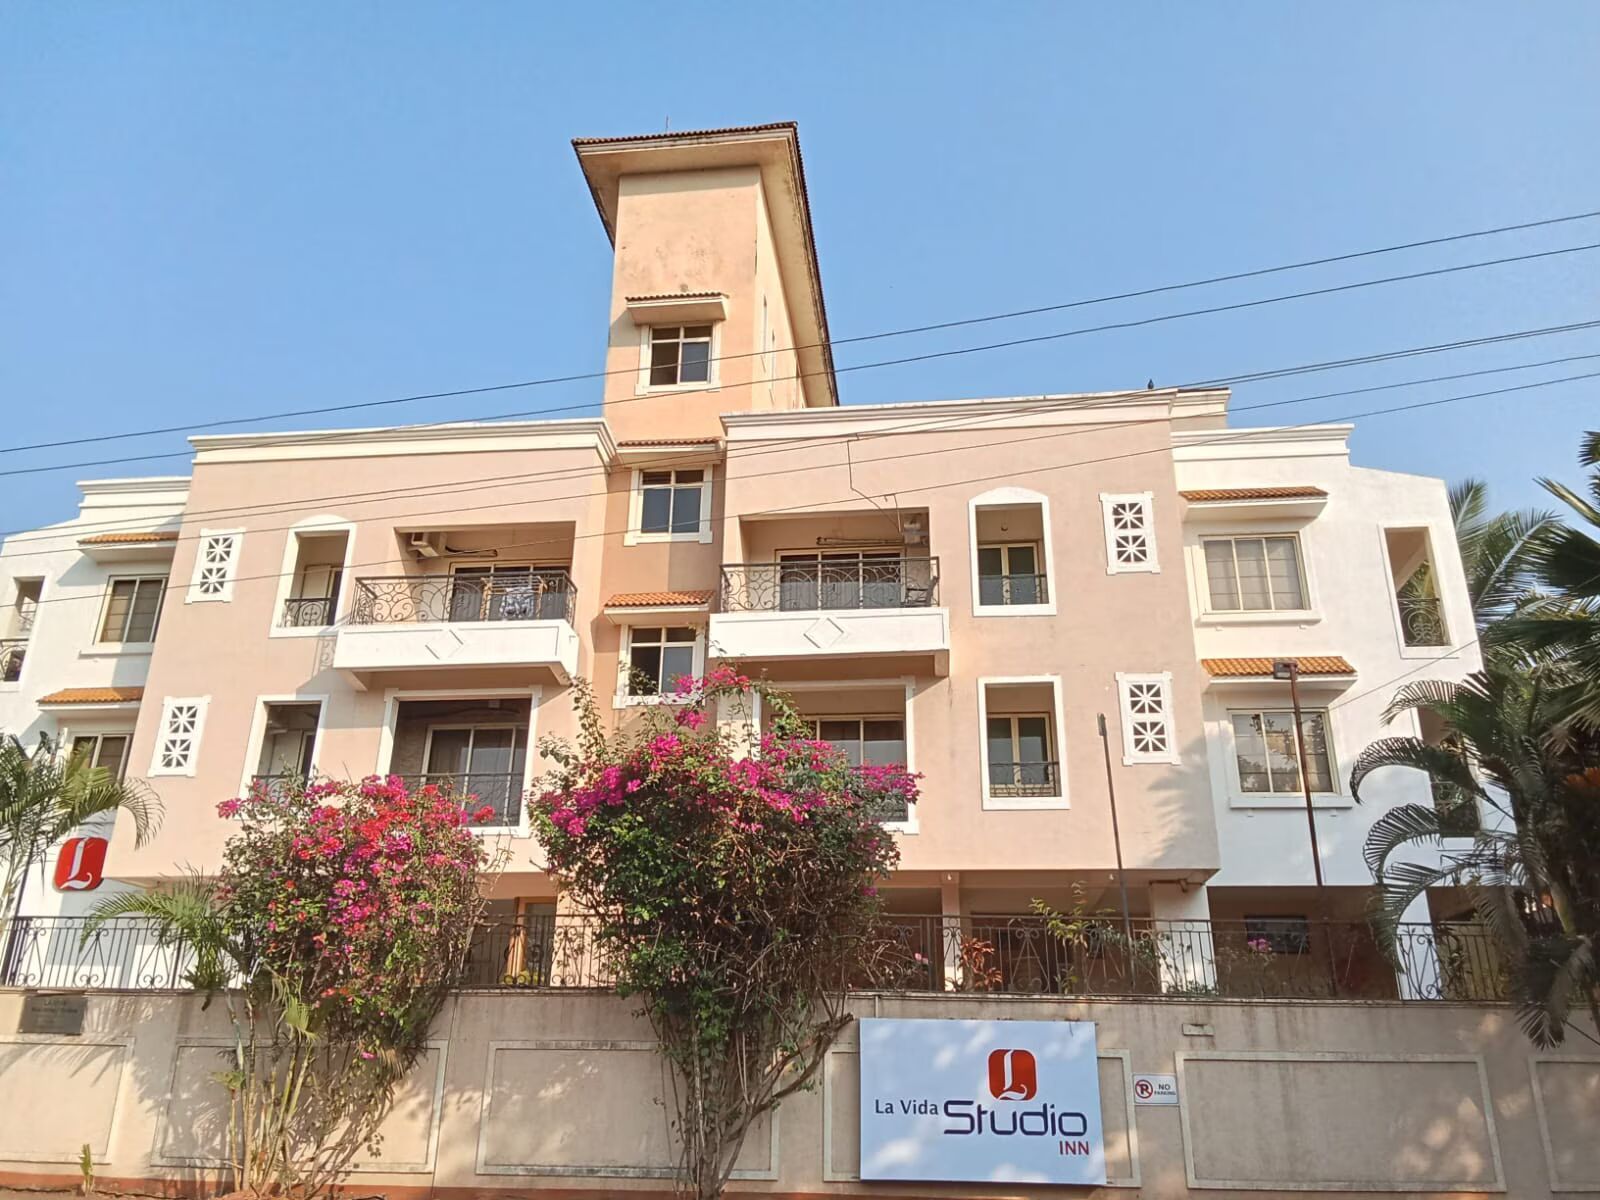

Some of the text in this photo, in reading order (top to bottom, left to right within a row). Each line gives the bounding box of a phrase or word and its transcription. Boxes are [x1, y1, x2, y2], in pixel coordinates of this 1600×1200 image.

[60, 837, 92, 889] L
[998, 1049, 1027, 1100] L
[875, 1099, 1088, 1137] La Vida Studio
[1059, 1141, 1089, 1155] INN
